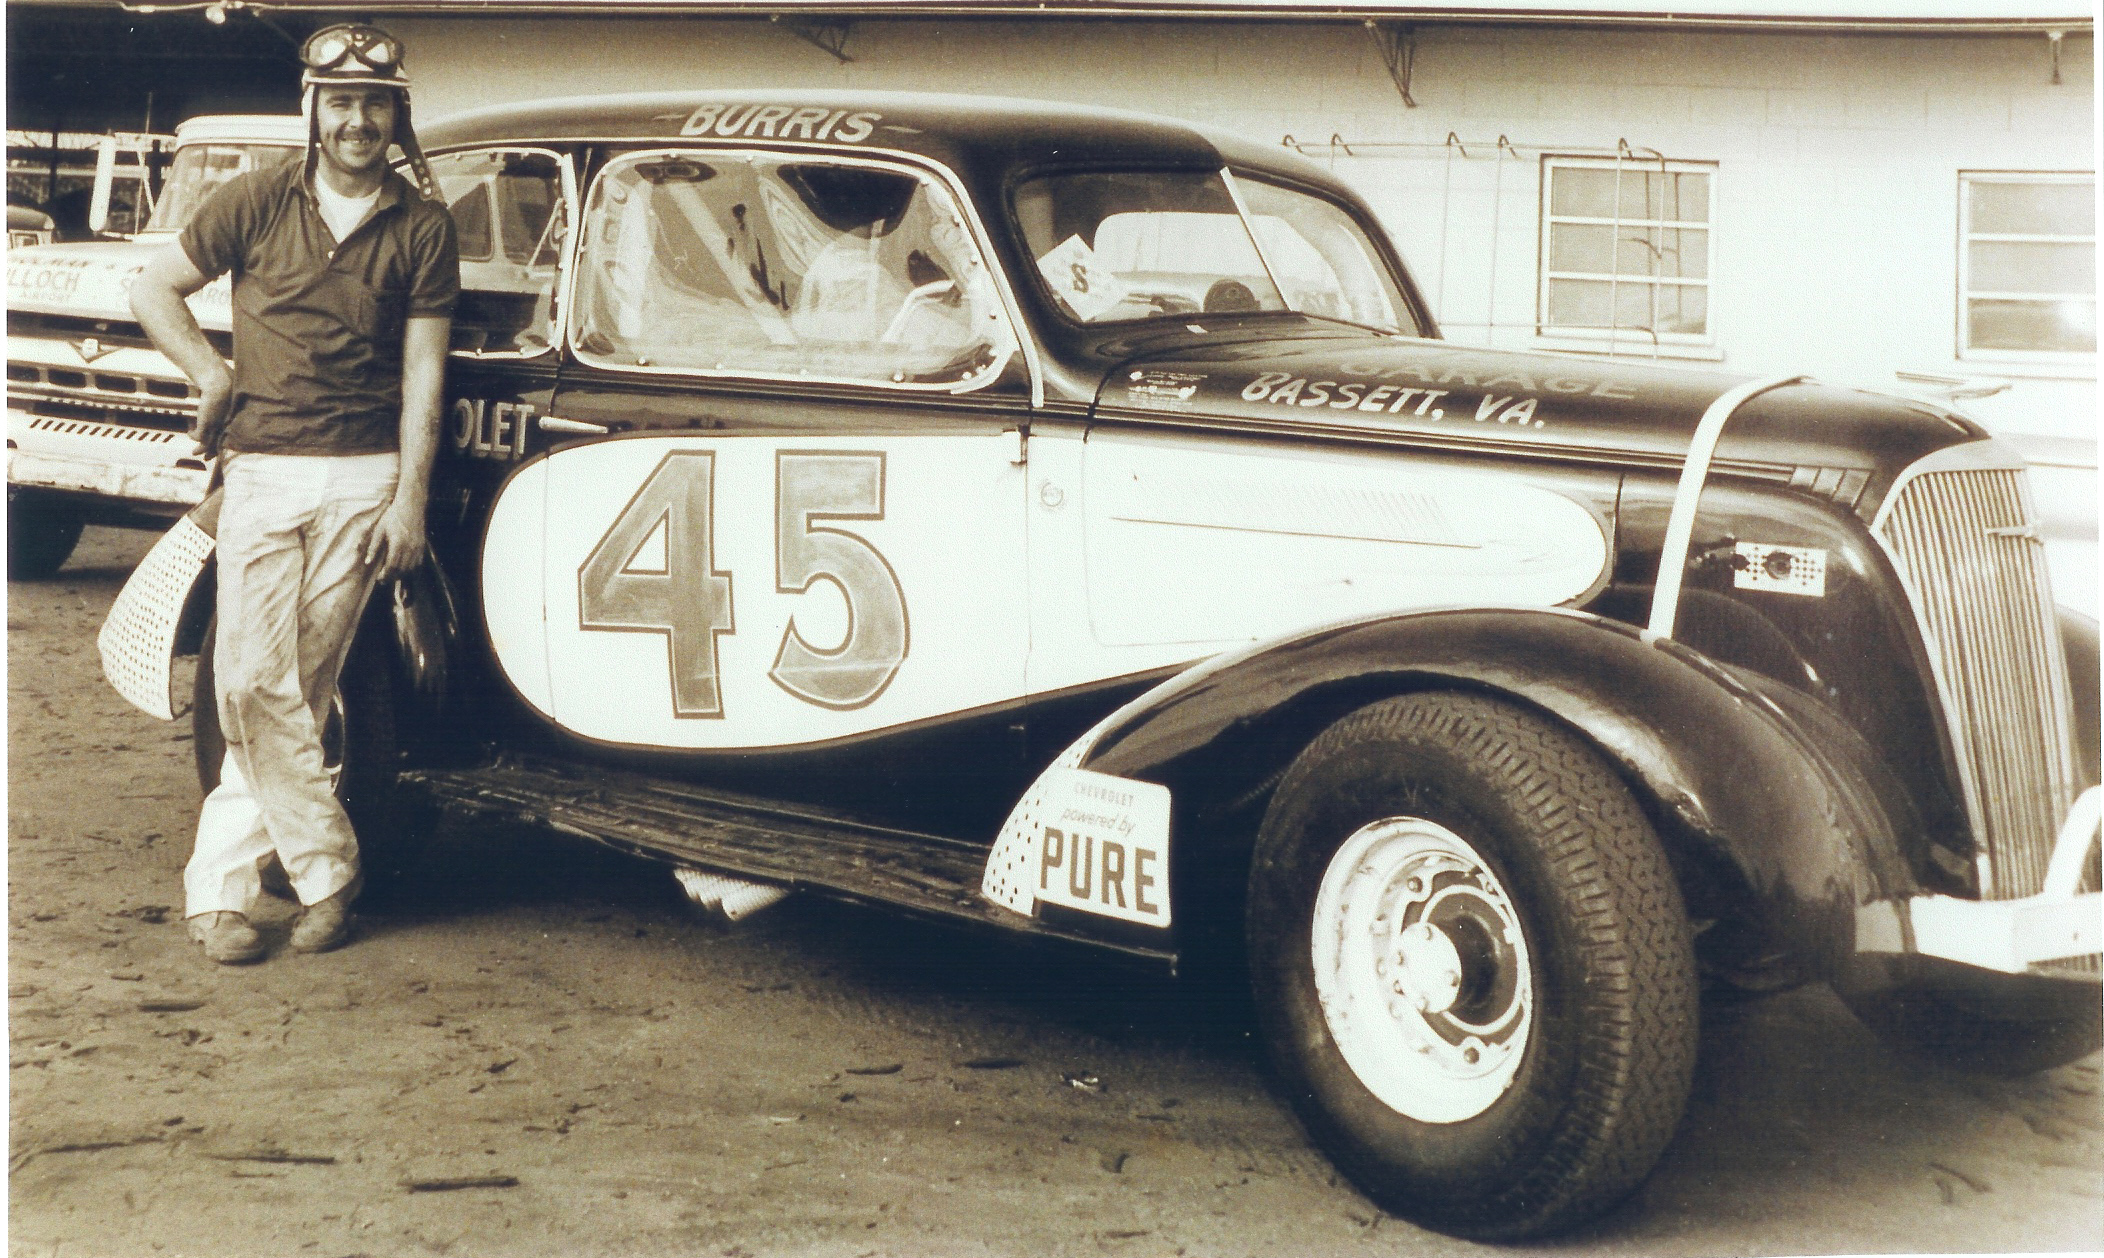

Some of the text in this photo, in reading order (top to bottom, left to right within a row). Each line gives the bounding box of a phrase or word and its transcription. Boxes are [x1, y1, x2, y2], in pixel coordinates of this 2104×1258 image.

[680, 104, 882, 142] BURRIS
[1071, 262, 1090, 294] S
[1341, 361, 1637, 400] GARAGE
[1241, 371, 1449, 422] BASSETT,
[1475, 393, 1545, 429] VA.
[577, 449, 910, 719] 45
[1074, 781, 1135, 808] CHEVROLET
[1059, 808, 1137, 837] powered by
[1040, 827, 1159, 915] PURE
